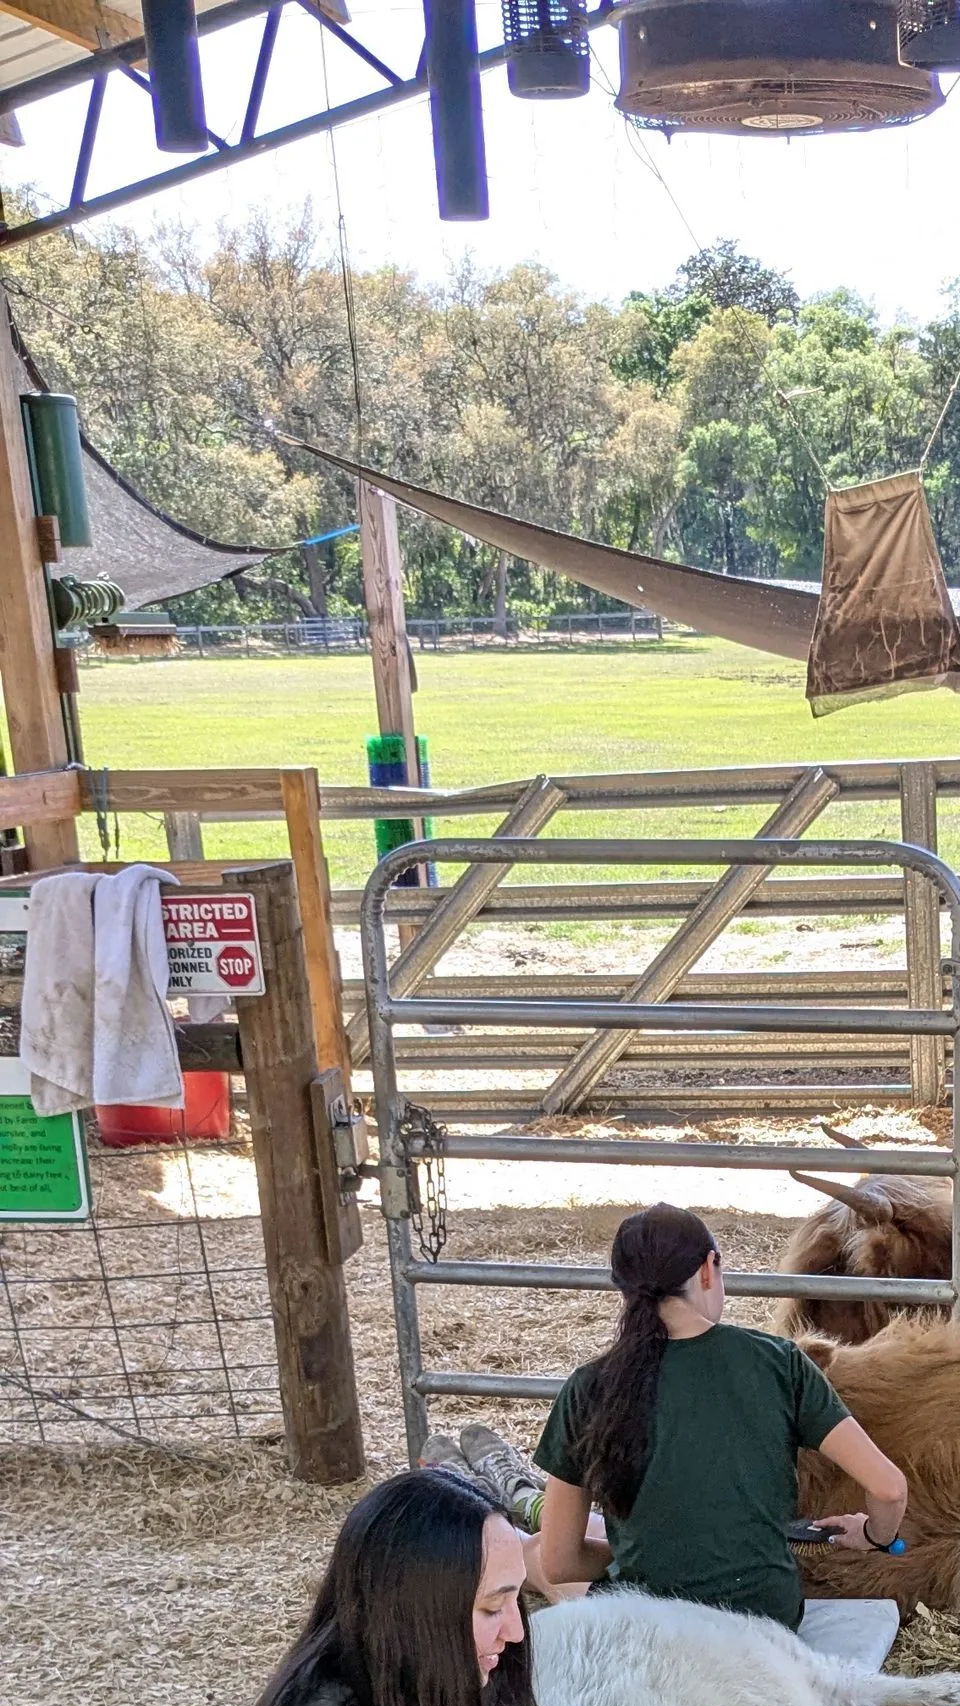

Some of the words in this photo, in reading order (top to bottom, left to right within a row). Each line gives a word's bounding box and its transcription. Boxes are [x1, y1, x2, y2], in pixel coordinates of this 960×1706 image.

[161, 903, 249, 921] STRICTED
[166, 922, 220, 939] AREA
[168, 947, 213, 959] ORIZED
[168, 961, 213, 974] SONNEL
[220, 958, 253, 975] STOP
